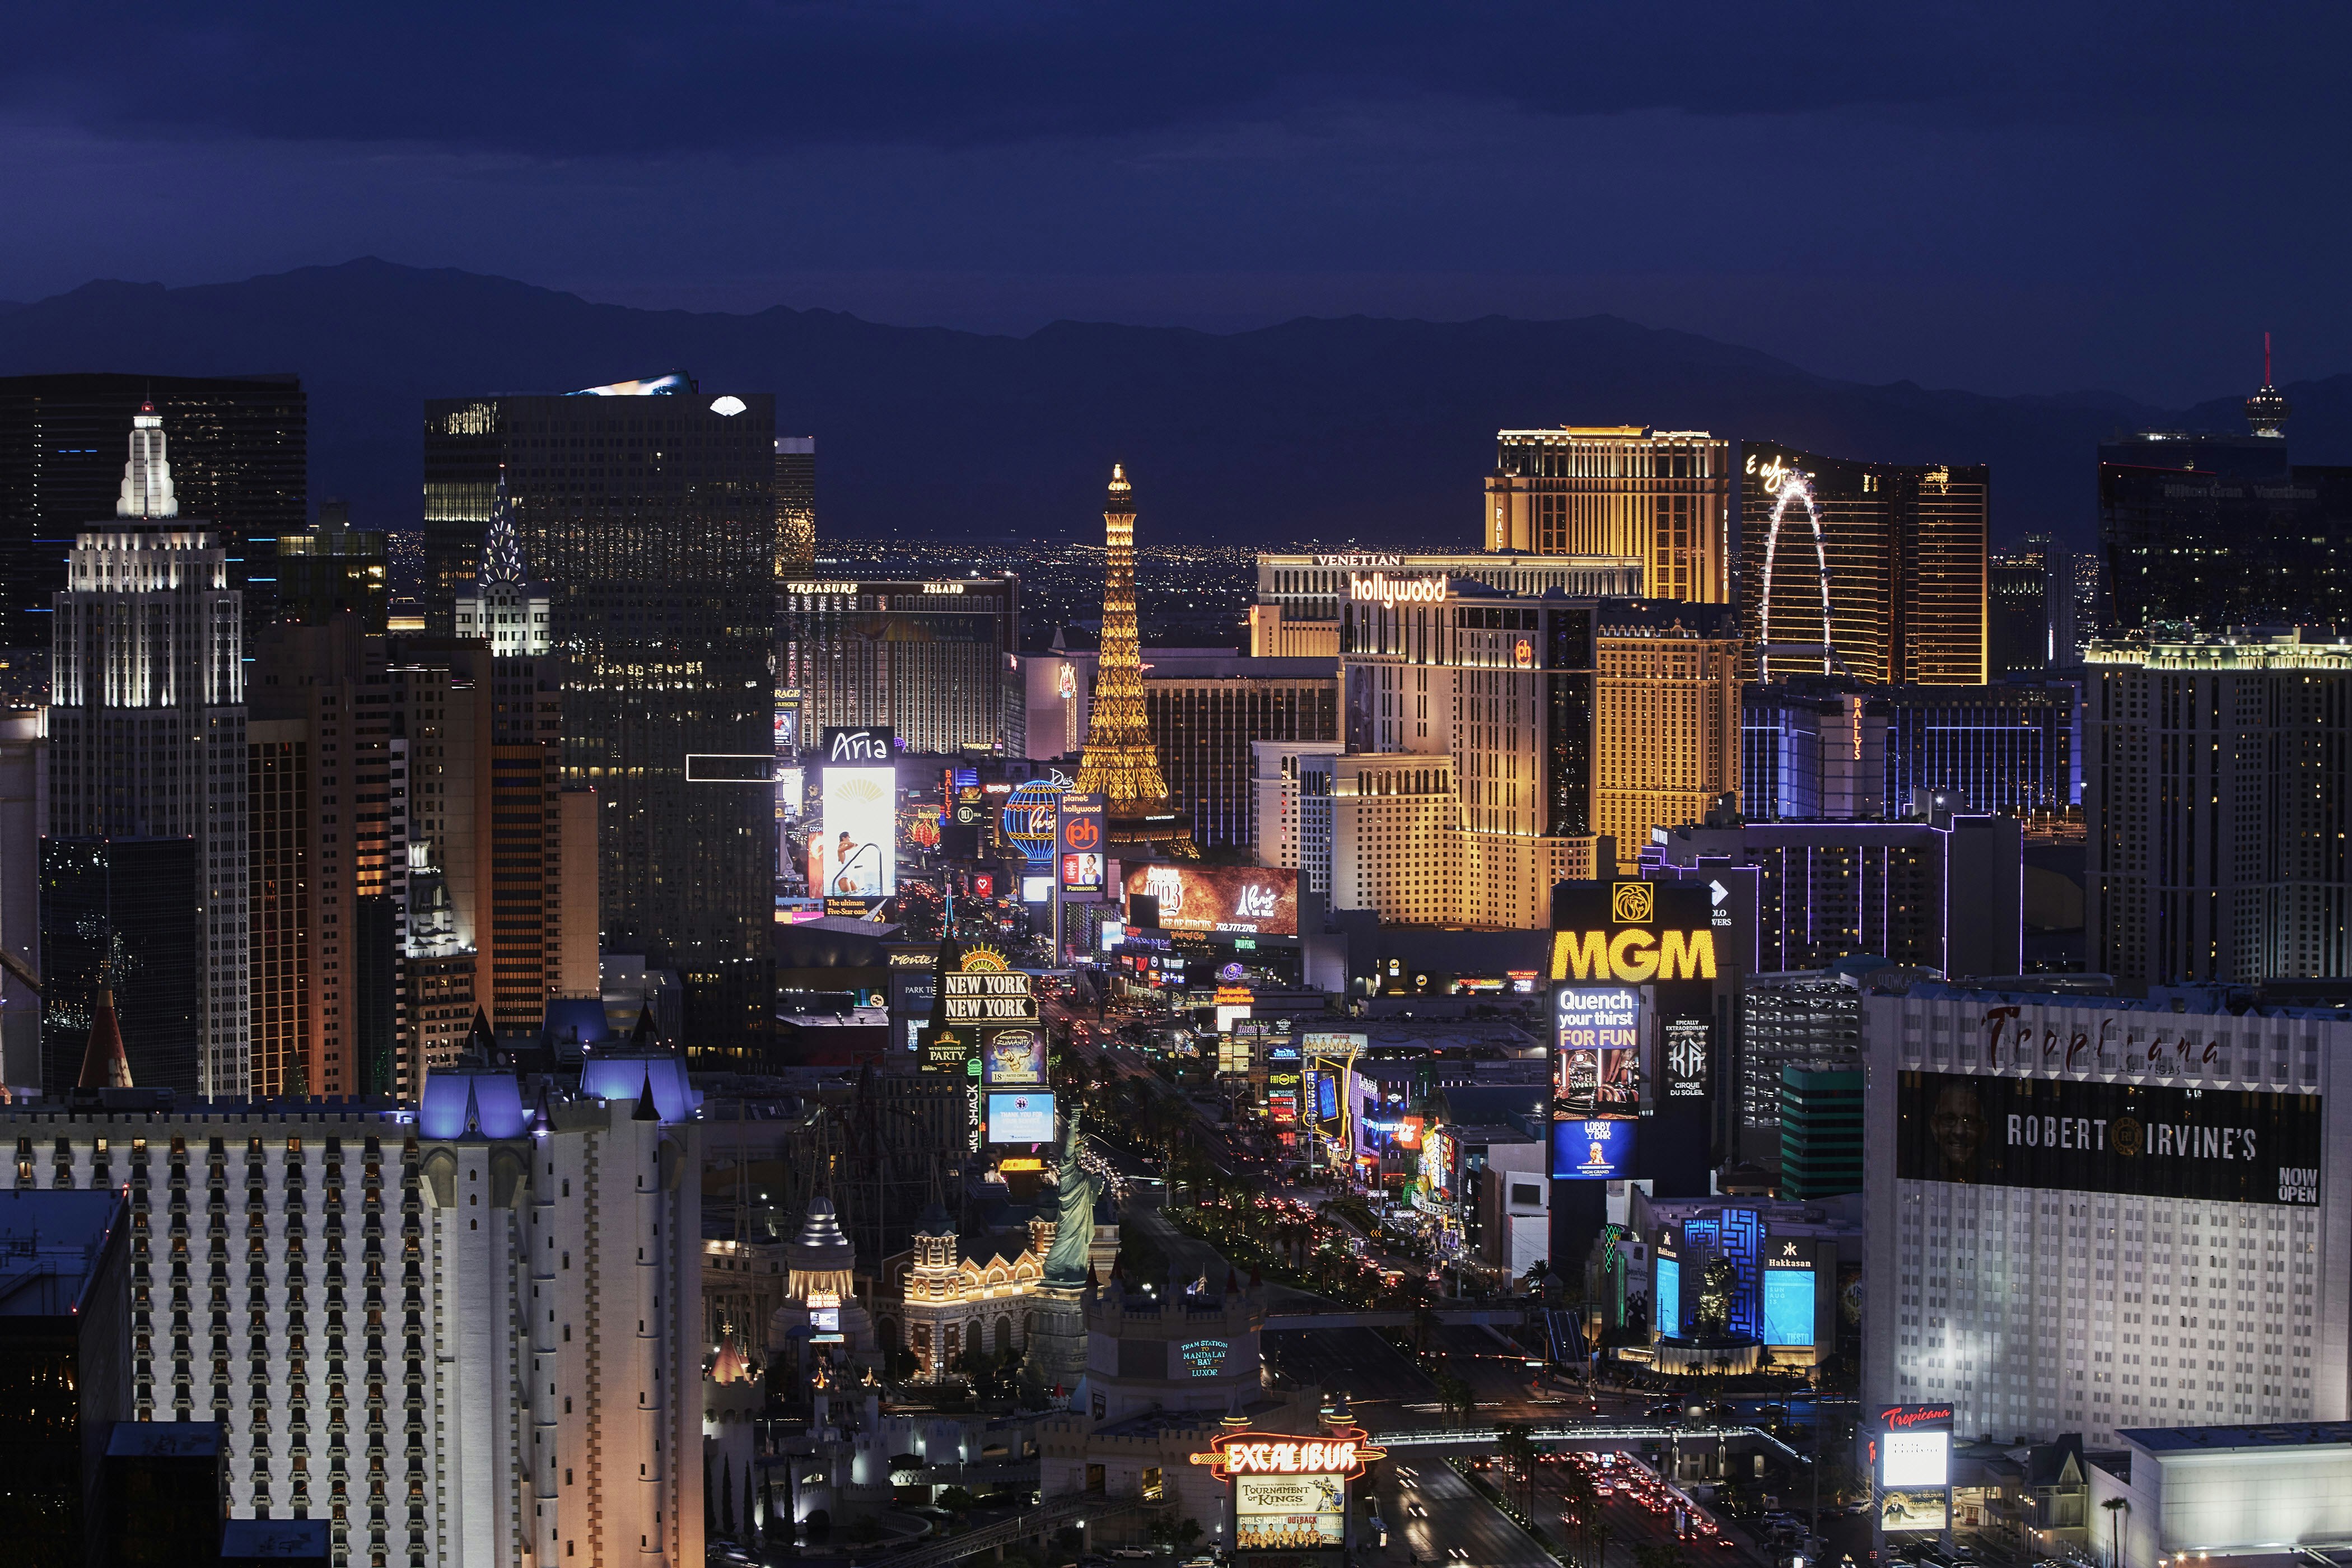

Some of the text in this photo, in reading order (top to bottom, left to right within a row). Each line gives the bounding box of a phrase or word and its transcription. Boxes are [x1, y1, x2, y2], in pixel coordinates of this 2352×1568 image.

[2210, 484, 2245, 498] Gran
[2253, 485, 2317, 500] Vacations
[1316, 554, 1401, 566] VENETIAN
[787, 583, 964, 594] TREASURE ISLAND
[1351, 572, 1446, 609] hollywood
[831, 732, 886, 762] Aria
[1063, 794, 1089, 804] planet
[960, 810, 969, 819] BLT
[1063, 805, 1102, 814] hollywood
[1030, 806, 1056, 838] Paris
[1068, 818, 1098, 844] ph
[1248, 885, 1276, 909] Paris
[1160, 918, 1211, 930] AGE OF CIRCUS
[1170, 931, 1192, 940] Rainforest
[1235, 939, 1256, 949] TWIN PEAKS
[890, 954, 932, 965] Monte
[1551, 928, 1717, 983] MGM
[945, 976, 1027, 994] NEW YORK
[1560, 990, 1632, 1010] Quench
[945, 999, 1027, 1017] NEW YORK
[1559, 1011, 1633, 1029] your thirst
[1560, 1029, 1636, 1046] FOR FUN
[930, 1051, 965, 1061] PARTY.
[2147, 1064, 2181, 1075] VEGAS
[1270, 1075, 1279, 1084] FAT
[1306, 1072, 1316, 1108] ROSS
[966, 1084, 978, 1126] SHACK
[1584, 1122, 1611, 1131] LOBBY
[1594, 1131, 1611, 1140] BAR
[2008, 1114, 2257, 1160] ROBERT IRVINE'S
[2279, 1166, 2318, 1187] NOW
[2278, 1186, 2317, 1203] OPEN
[1657, 1247, 1677, 1258] Hakkasan
[1768, 1259, 1811, 1267] Hakkasan
[1181, 1340, 1228, 1351] TRAM STATION
[1881, 1407, 1950, 1431] Tropicana
[1230, 1442, 1357, 1472] EXCALIBUR
[1242, 1485, 1310, 1496] TOURNAMENT
[1257, 1494, 1304, 1505] KINGS
[1239, 1516, 1263, 1524] GIRLS'
